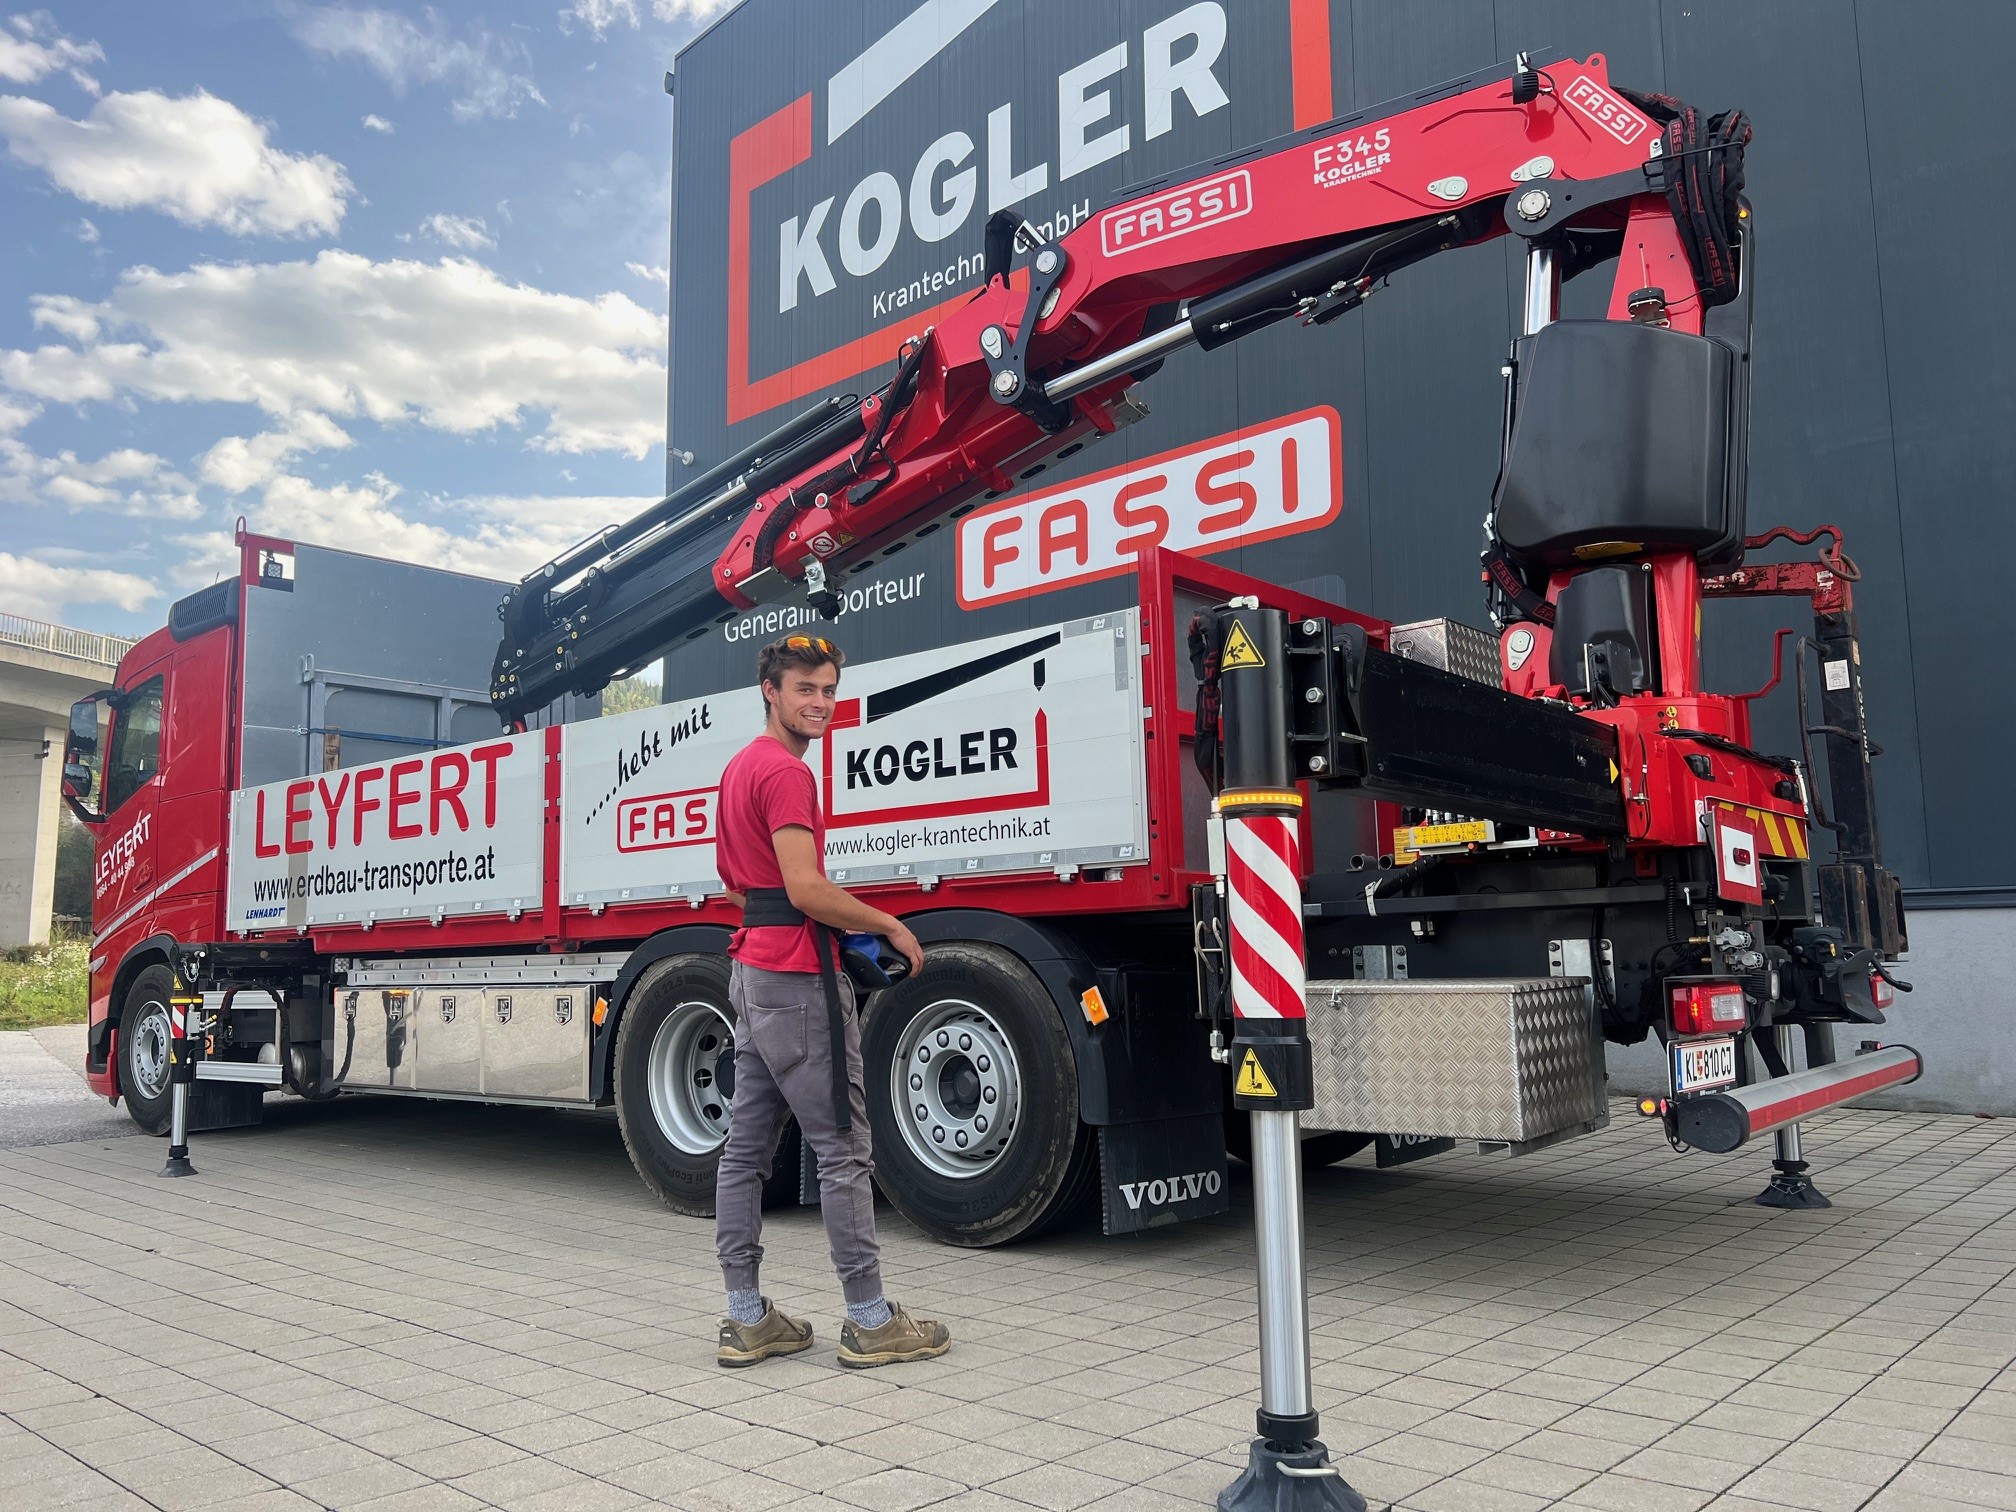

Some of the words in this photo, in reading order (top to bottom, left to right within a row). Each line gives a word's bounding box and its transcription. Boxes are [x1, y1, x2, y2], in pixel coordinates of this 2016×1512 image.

[1573, 84, 1638, 136] FASSI
[779, 1, 1230, 314] KOGLER
[1313, 128, 1391, 171] F345
[1313, 152, 1391, 184] KOGLER
[1323, 166, 1382, 189] KRANTECHNIK
[1113, 182, 1238, 246] FASSI
[873, 251, 985, 319] Krantechn
[983, 436, 1299, 590] FASSI
[671, 703, 712, 747] mit
[847, 727, 1018, 790] KOGLER
[255, 742, 514, 858] LEYFERT
[629, 798, 707, 843] FAS
[95, 813, 152, 886] LEYFERT
[824, 817, 1051, 856] www.kogler-krantechnik.at
[254, 845, 496, 902] www.erdbau-transporte.at
[245, 907, 286, 919] LENHARDT
[1119, 1170, 1221, 1210] VOLVO
